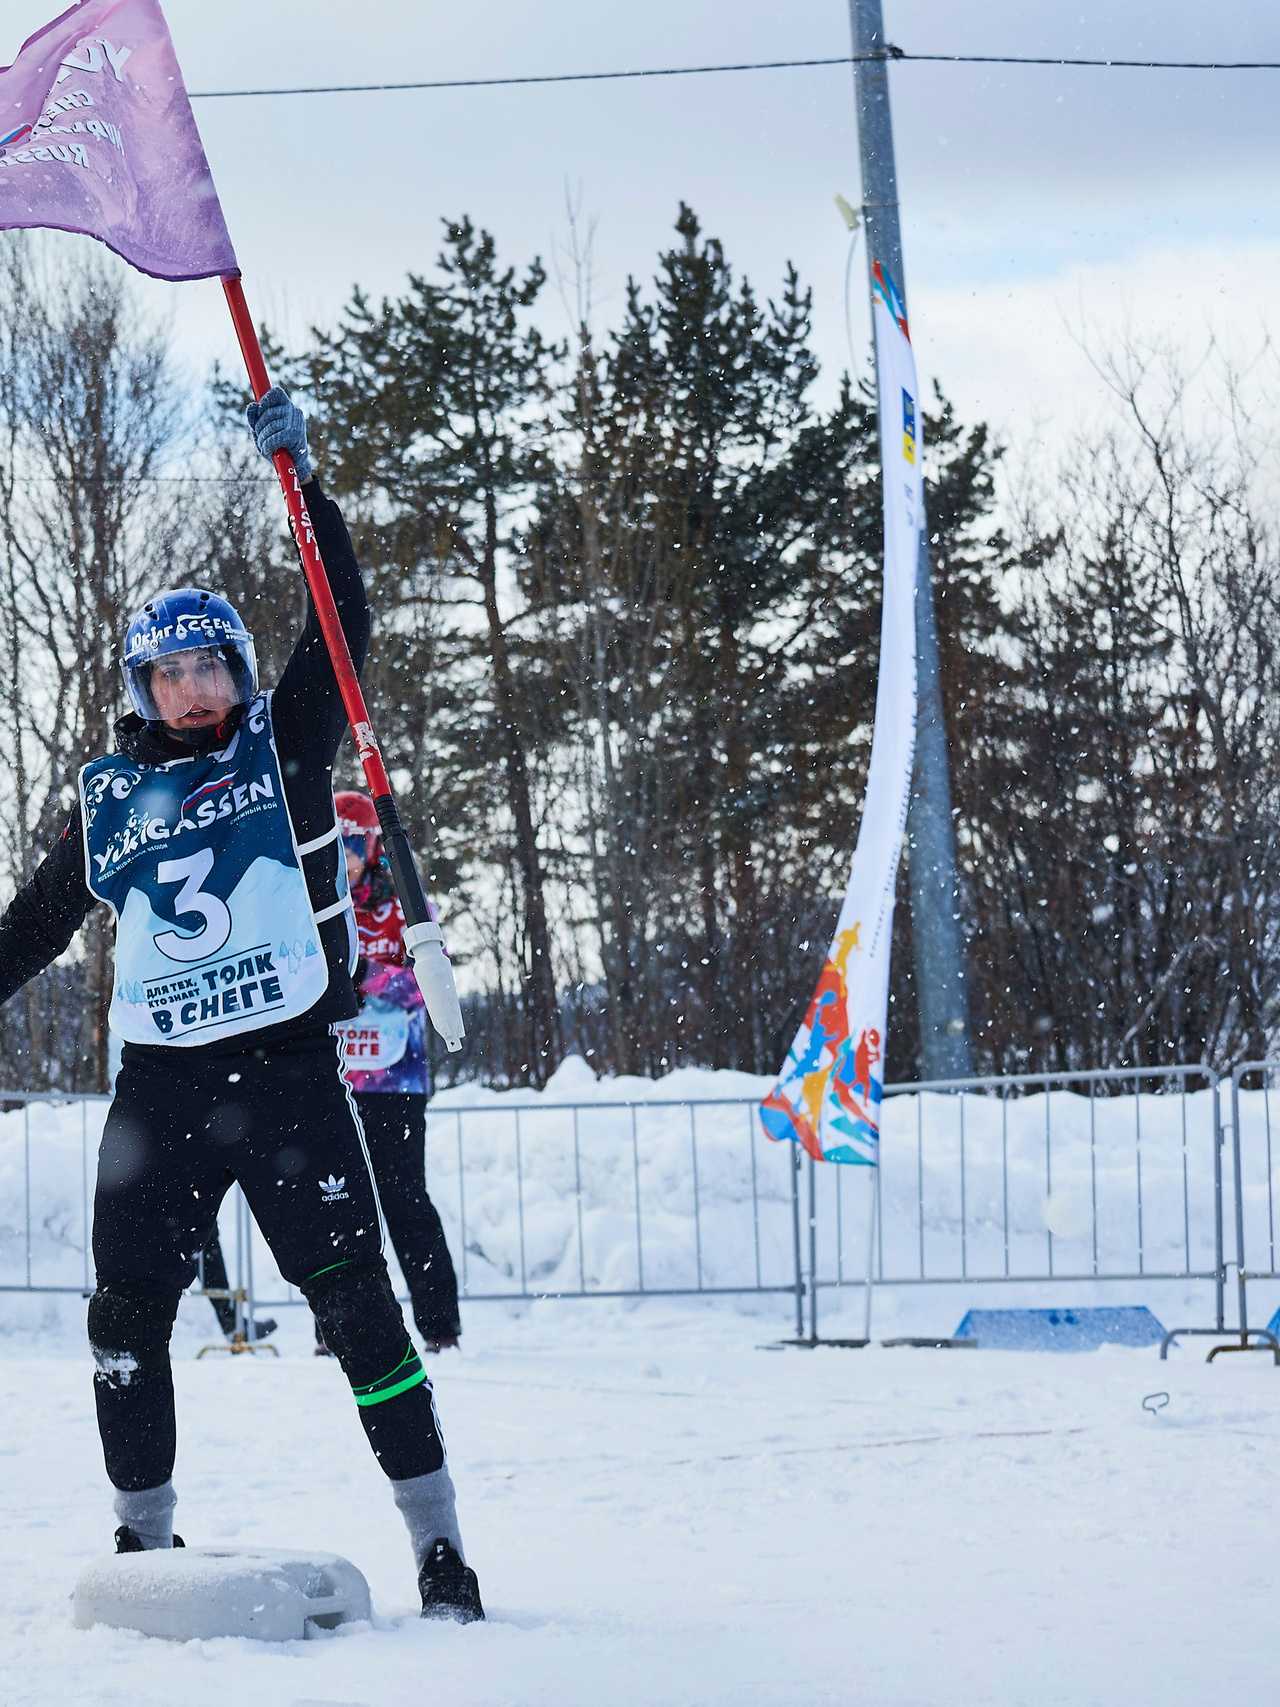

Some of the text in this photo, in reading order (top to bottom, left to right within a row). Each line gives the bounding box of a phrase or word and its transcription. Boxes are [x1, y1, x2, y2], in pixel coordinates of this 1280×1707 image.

[262, 801, 278, 811] БОЙ
[93, 773, 275, 874] YUKIGASSEN
[152, 847, 233, 964] 3
[359, 938, 400, 956] SSEN
[201, 951, 277, 992] ТОЛК
[146, 978, 198, 1000] ДЛЯ ТЕХ,
[148, 988, 200, 1008] КТО ЗНАЕТ
[151, 975, 284, 1034] В СНЕГЕ
[336, 1029, 380, 1041] ТОЛК
[346, 1043, 380, 1056] ЕГЕ
[321, 1191, 350, 1202] adidas
